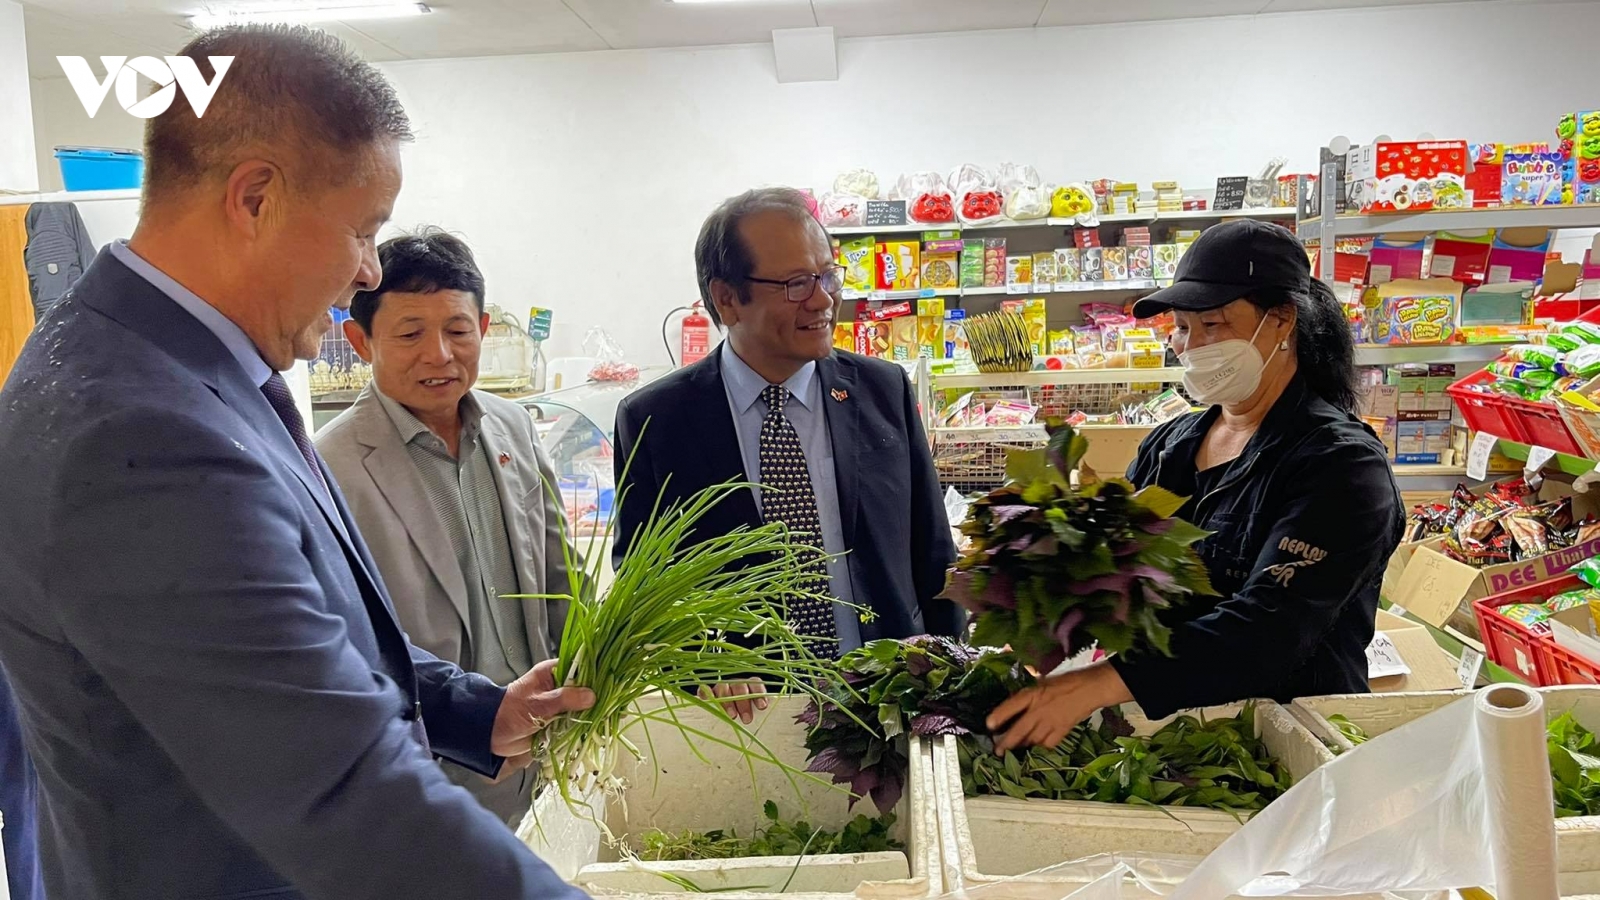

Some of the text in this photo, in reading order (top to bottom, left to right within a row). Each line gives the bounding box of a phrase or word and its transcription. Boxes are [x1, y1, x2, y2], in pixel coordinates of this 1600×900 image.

[1507, 161, 1555, 175] Bubble
[846, 247, 868, 262] Tipo
[881, 254, 898, 286] Tipo
[1278, 537, 1328, 561] REPLAY
[1225, 568, 1248, 579] REP
[1490, 564, 1537, 592] DEE
[1547, 546, 1586, 568] Thai
